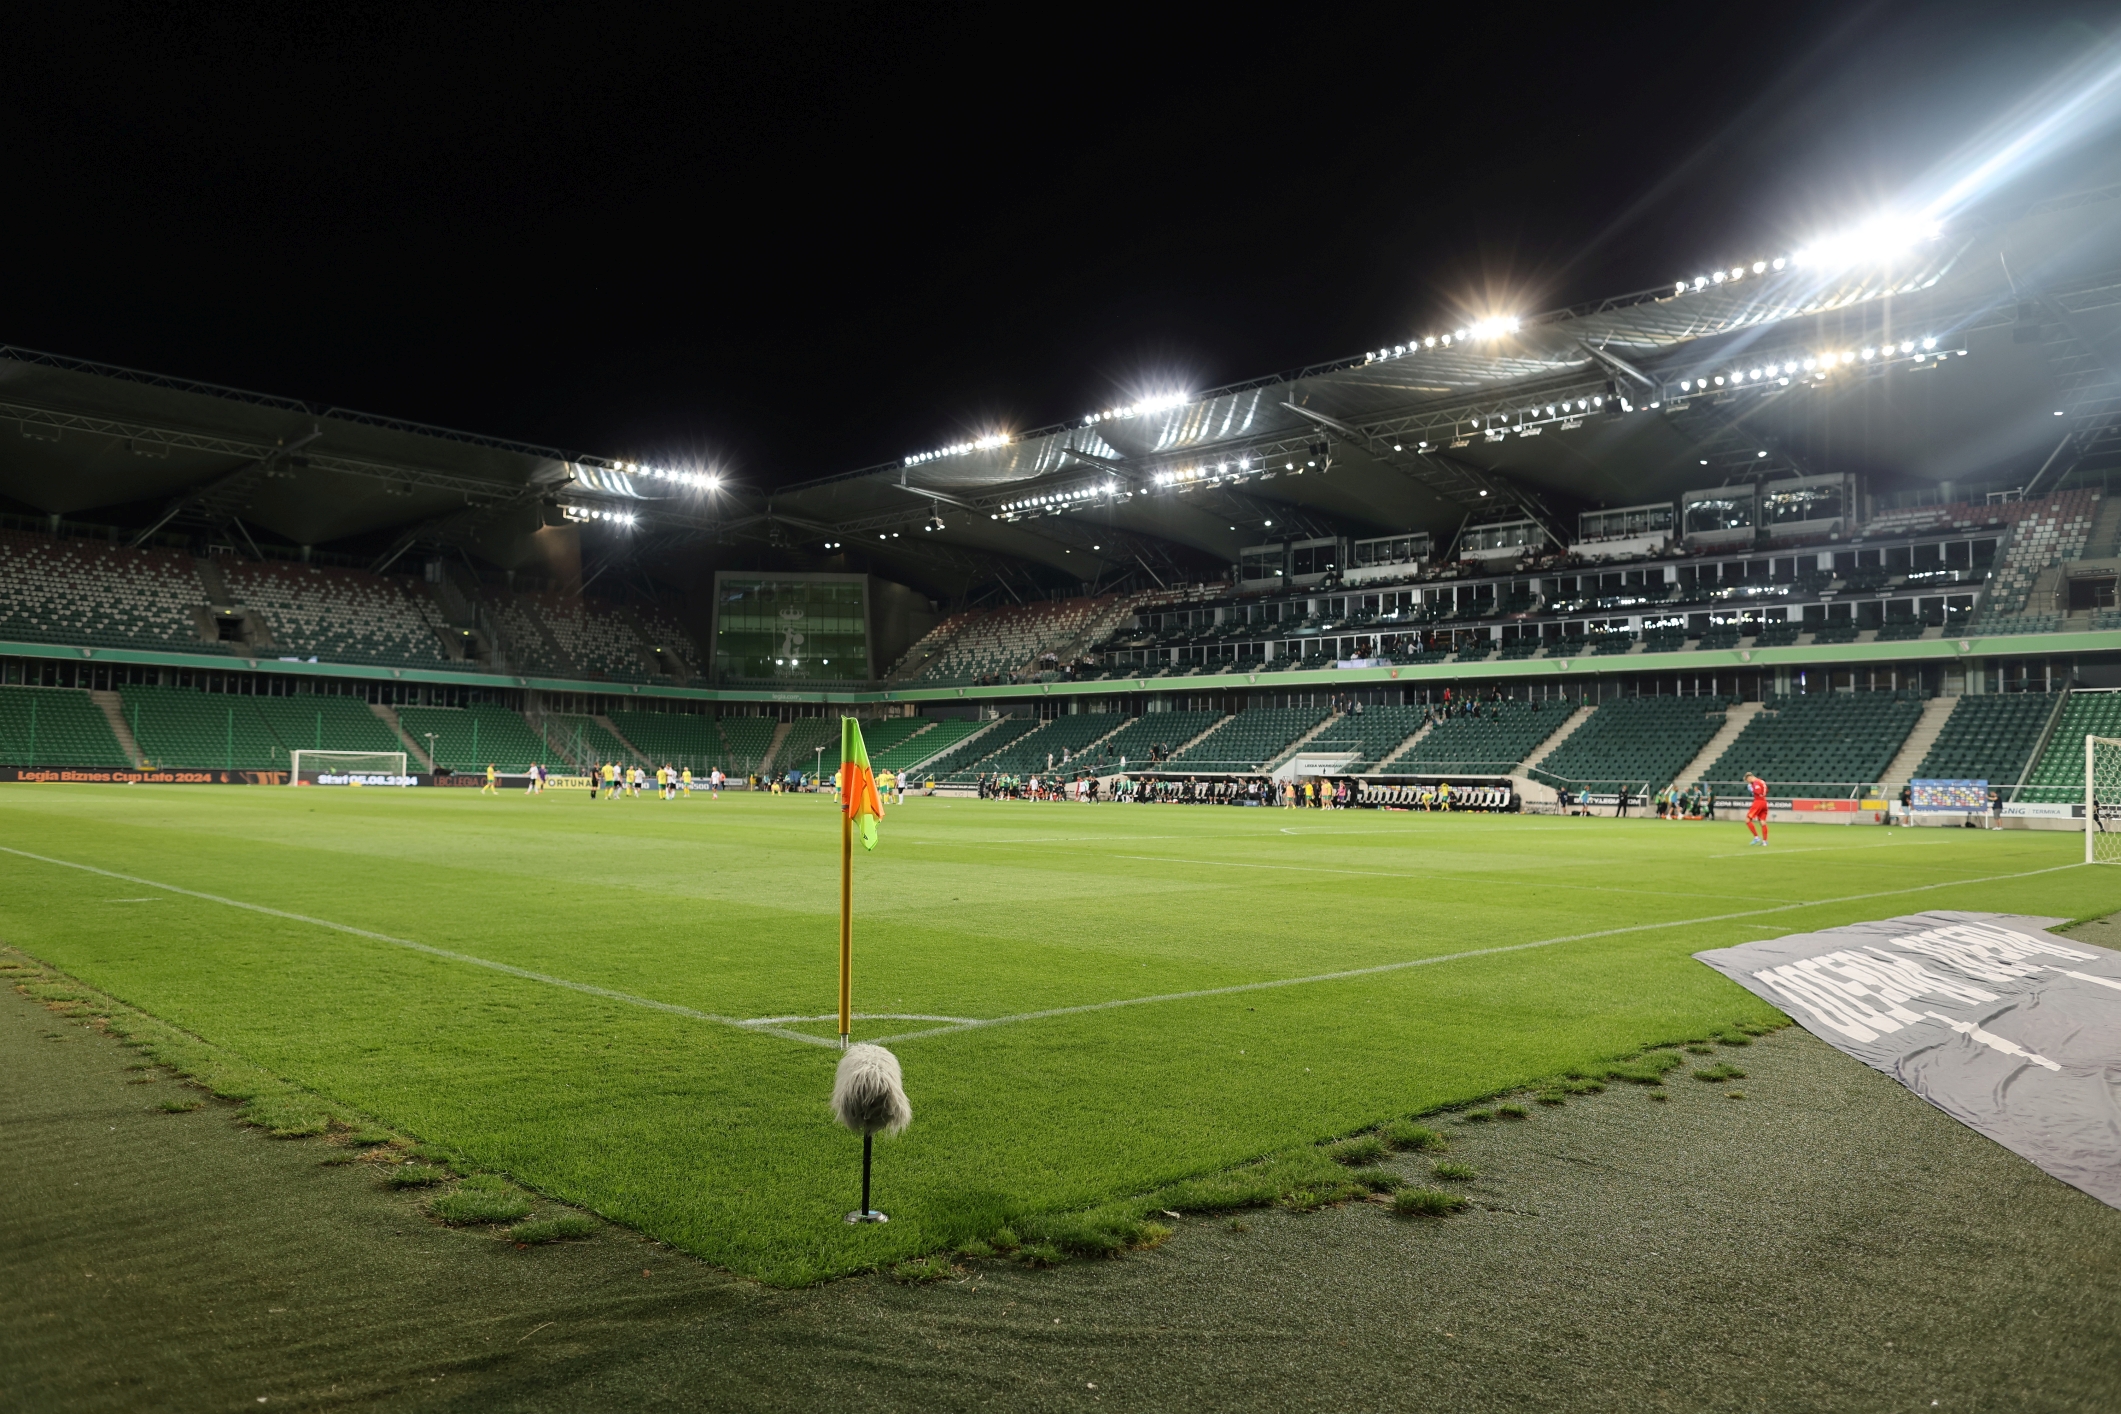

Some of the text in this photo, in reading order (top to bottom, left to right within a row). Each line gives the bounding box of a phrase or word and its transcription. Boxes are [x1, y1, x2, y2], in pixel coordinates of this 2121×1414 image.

[17, 770, 212, 783] Legia Biznes Cup Lato 2024
[317, 774, 349, 785] Start
[547, 778, 592, 788] ORTUNA
[2001, 807, 2026, 815] GNiG
[1753, 945, 2001, 1043] Plus500
